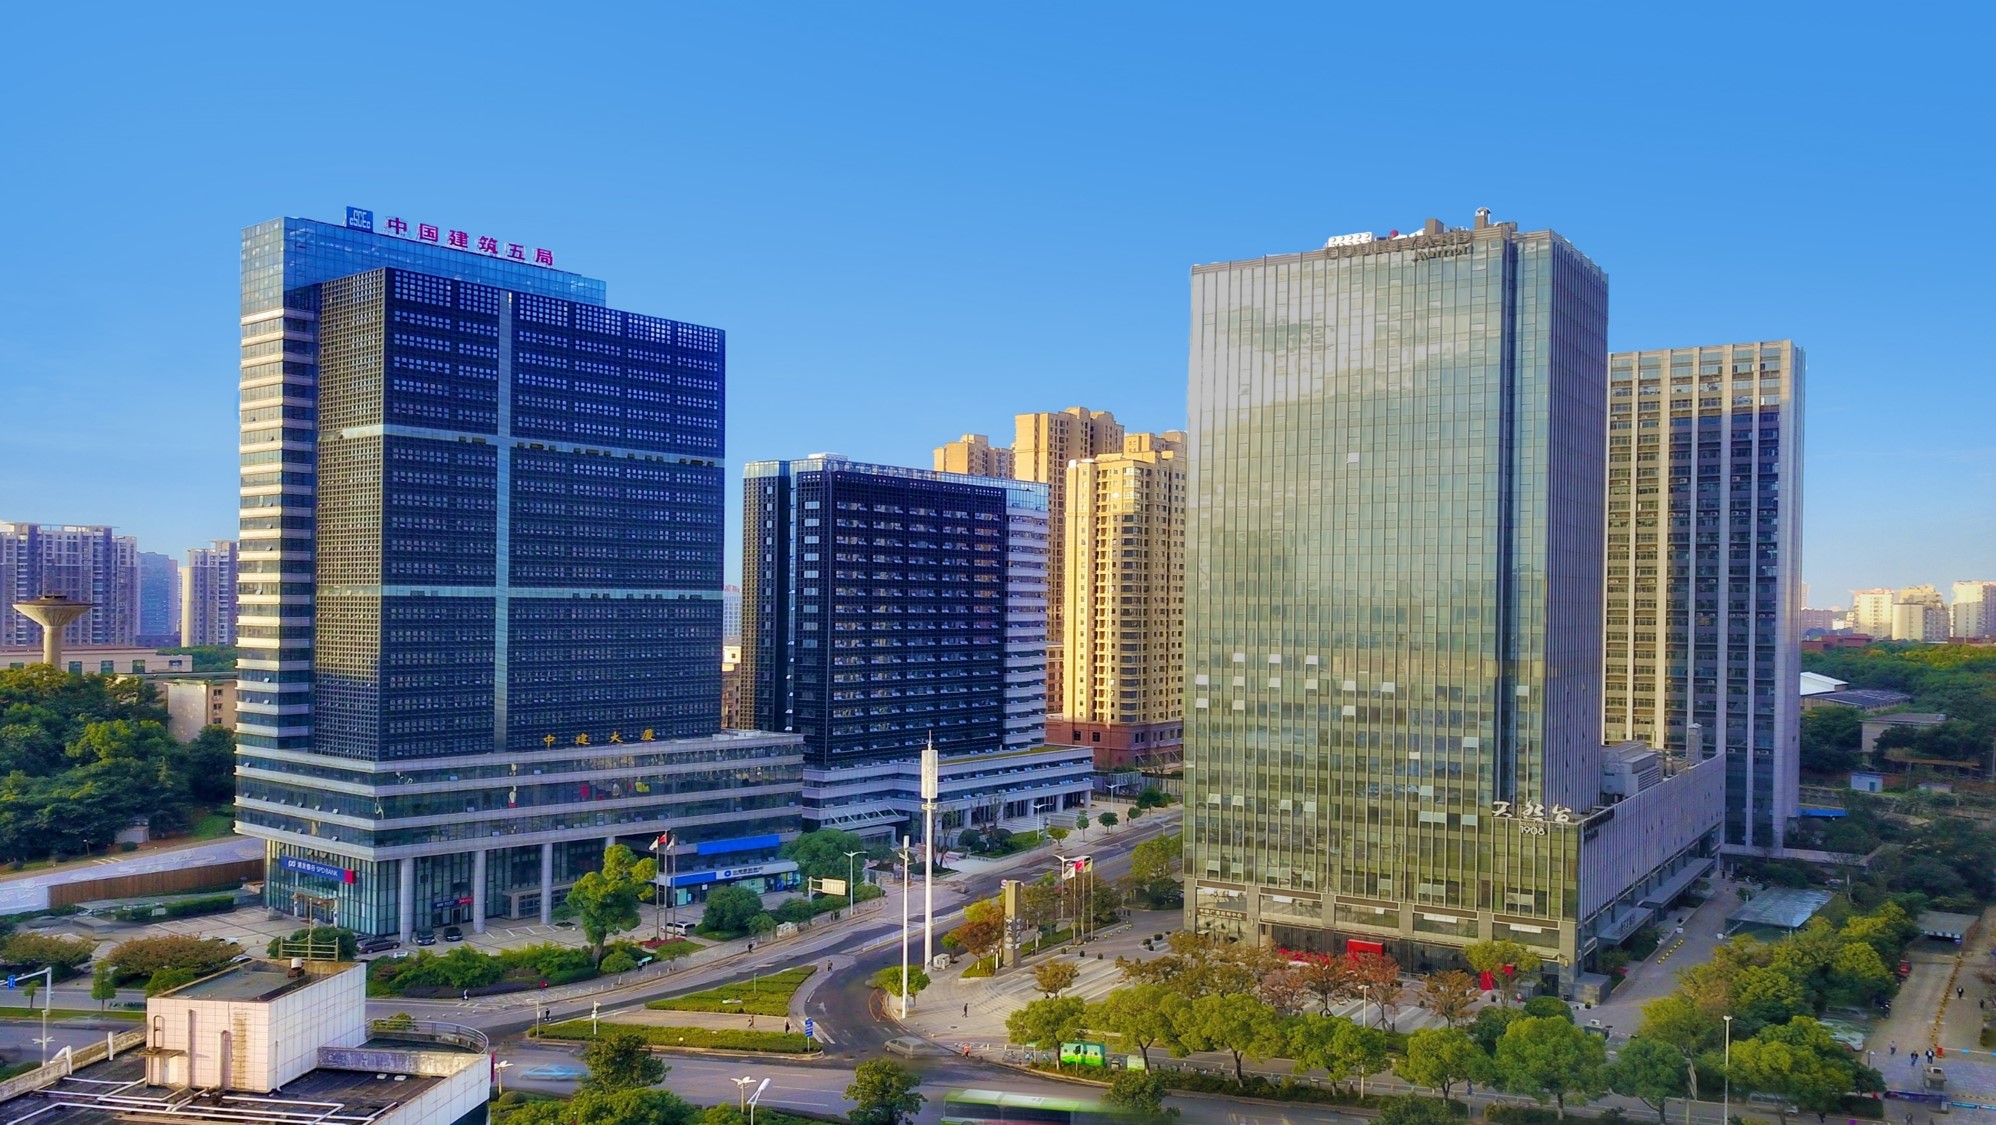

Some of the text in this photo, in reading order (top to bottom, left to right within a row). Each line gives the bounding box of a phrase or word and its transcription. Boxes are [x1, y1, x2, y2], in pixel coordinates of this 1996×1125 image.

[387, 217, 553, 265] 中国建筑五局
[1520, 826, 1545, 836] 1908
